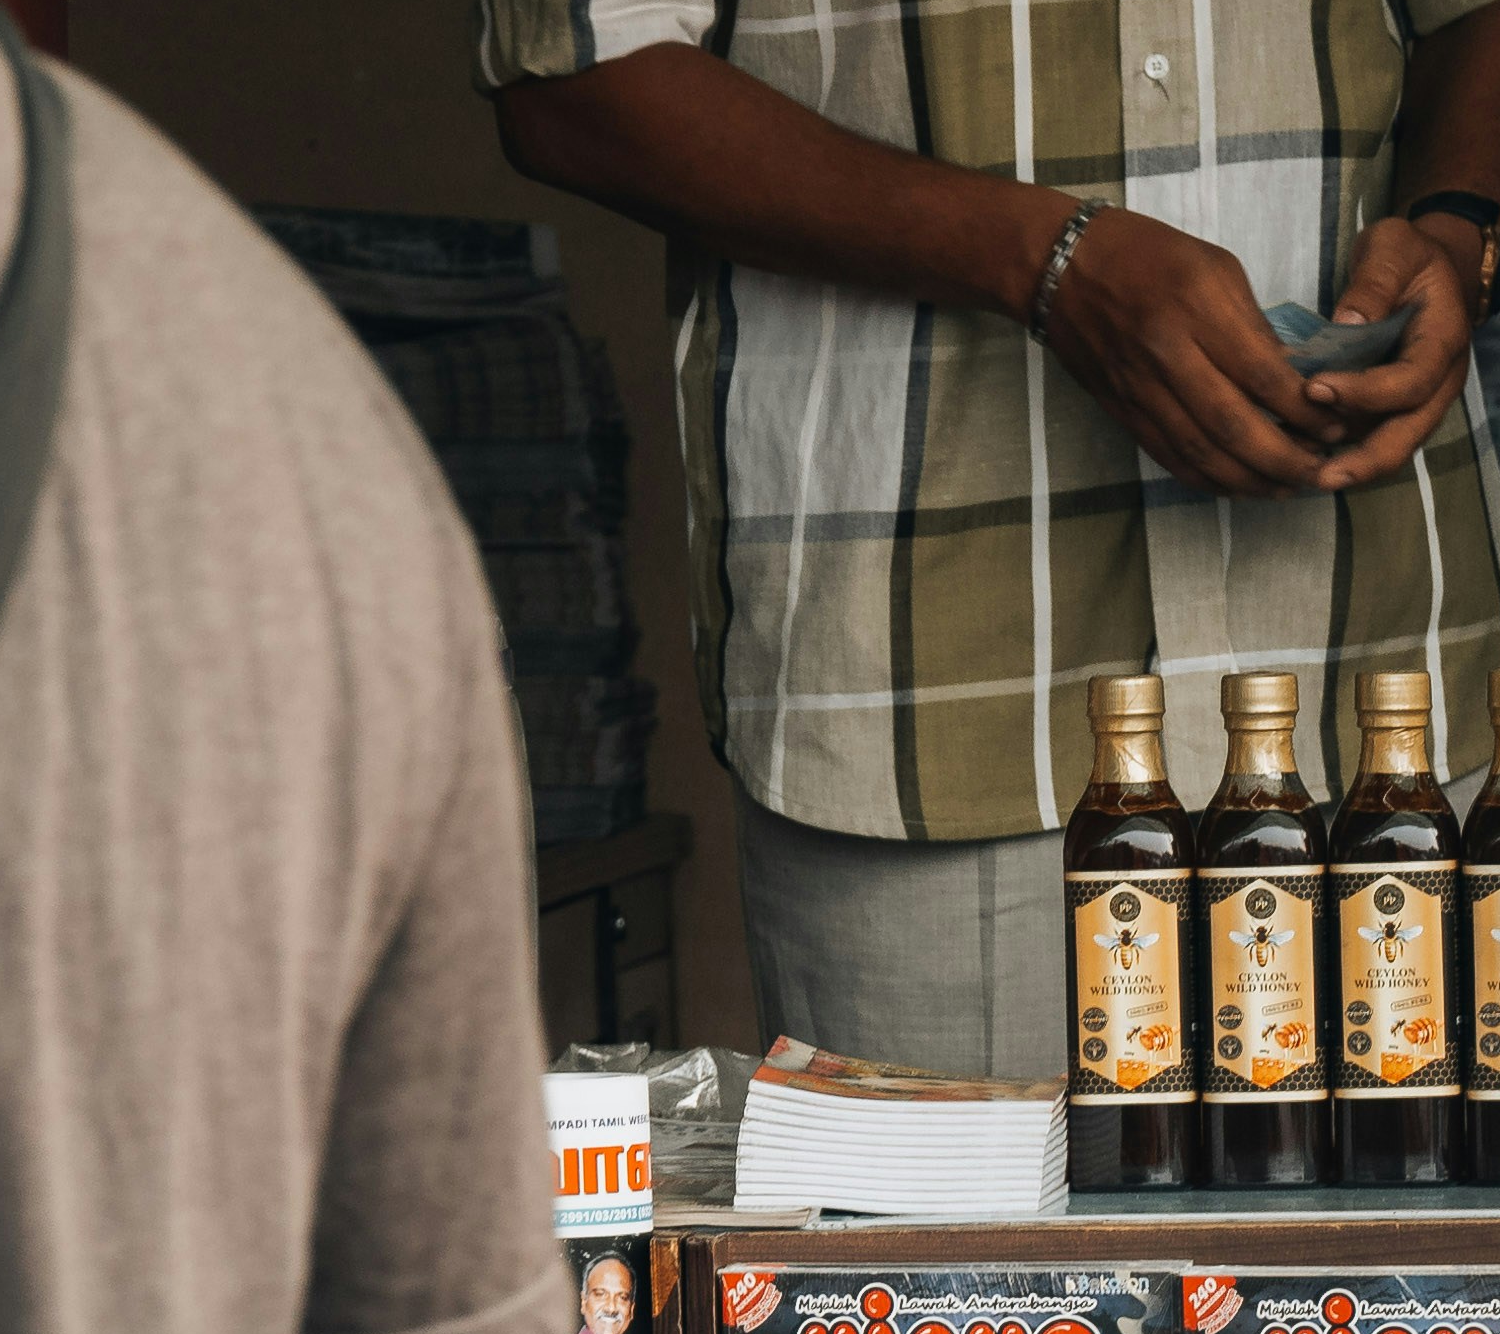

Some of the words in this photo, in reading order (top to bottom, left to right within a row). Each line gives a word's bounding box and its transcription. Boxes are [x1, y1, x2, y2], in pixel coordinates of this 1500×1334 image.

[1239, 972, 1287, 982] CEYLON
[1367, 968, 1416, 978] CEYLON
[1103, 974, 1152, 985] CEYLON
[1354, 978, 1386, 989] WILD
[1389, 977, 1430, 988] HONEY
[1090, 986, 1121, 996] WILD
[1124, 984, 1166, 995] HONEY
[1225, 983, 1256, 993] WILD
[1259, 982, 1301, 992] HONEY
[591, 1117, 626, 1128] TAMIL
[727, 1273, 753, 1302] 240
[1189, 1277, 1217, 1310] 240
[798, 1297, 858, 1315] Majalah
[899, 1297, 959, 1312] Lawak
[965, 1296, 1096, 1315] Antarabangsa
[1258, 1302, 1318, 1319] Majalah
[1360, 1302, 1421, 1317] Lawak
